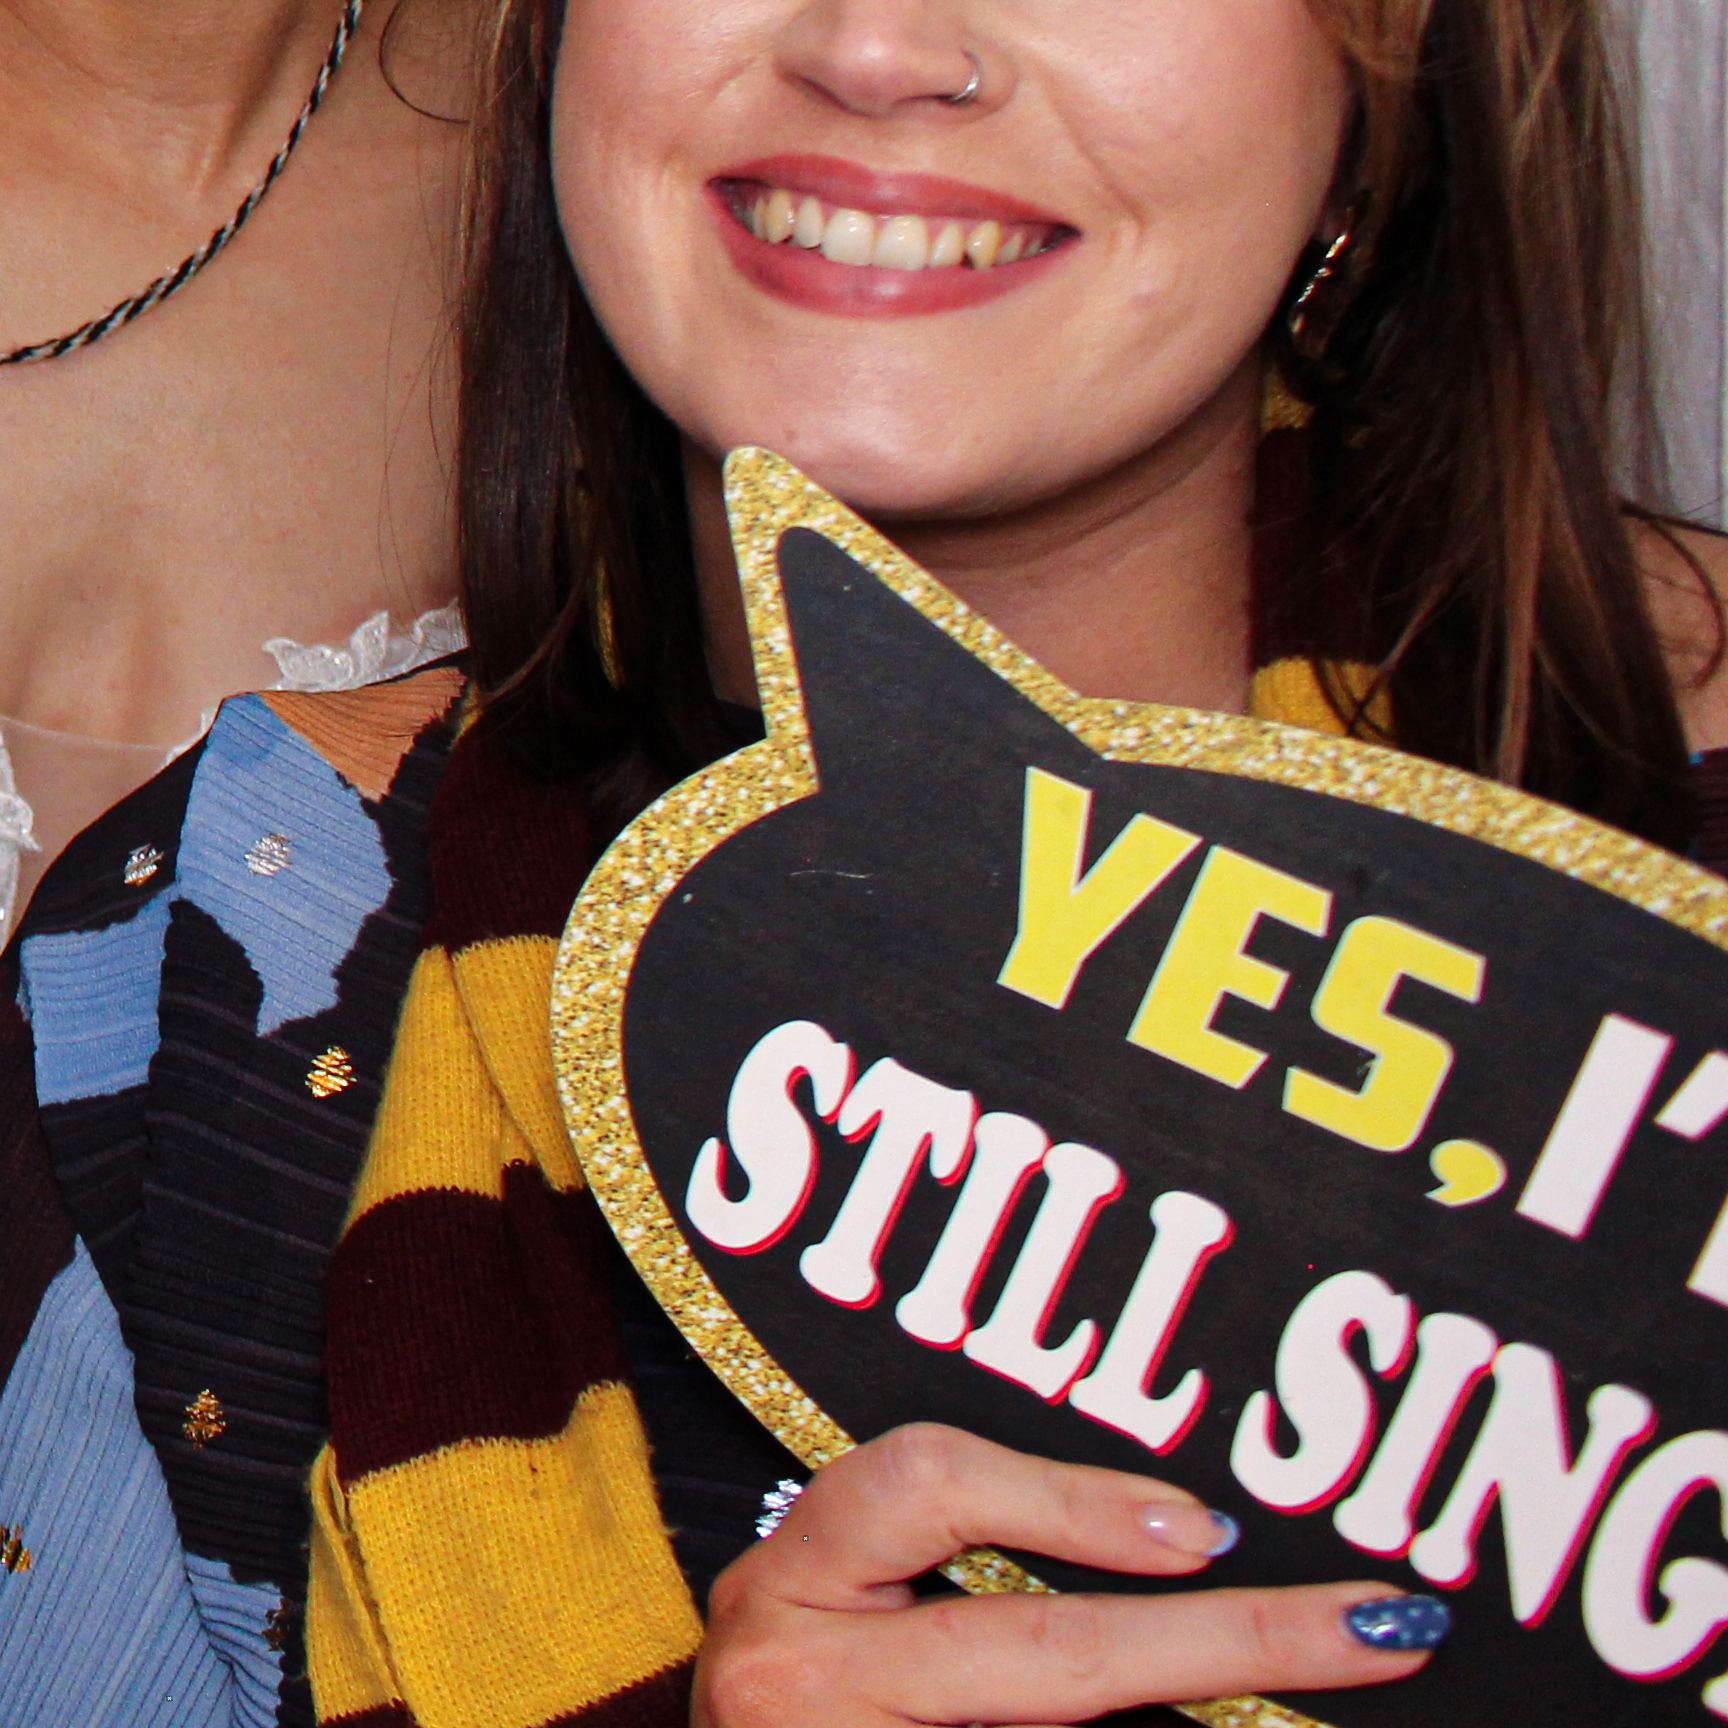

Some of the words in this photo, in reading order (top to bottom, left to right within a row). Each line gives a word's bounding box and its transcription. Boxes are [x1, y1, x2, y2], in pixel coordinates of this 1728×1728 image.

[996, 765, 1508, 1208] YES,
[1515, 1012, 1728, 1308] I'
[684, 1019, 1235, 1454] STILL
[1231, 1269, 1728, 1720] SING
